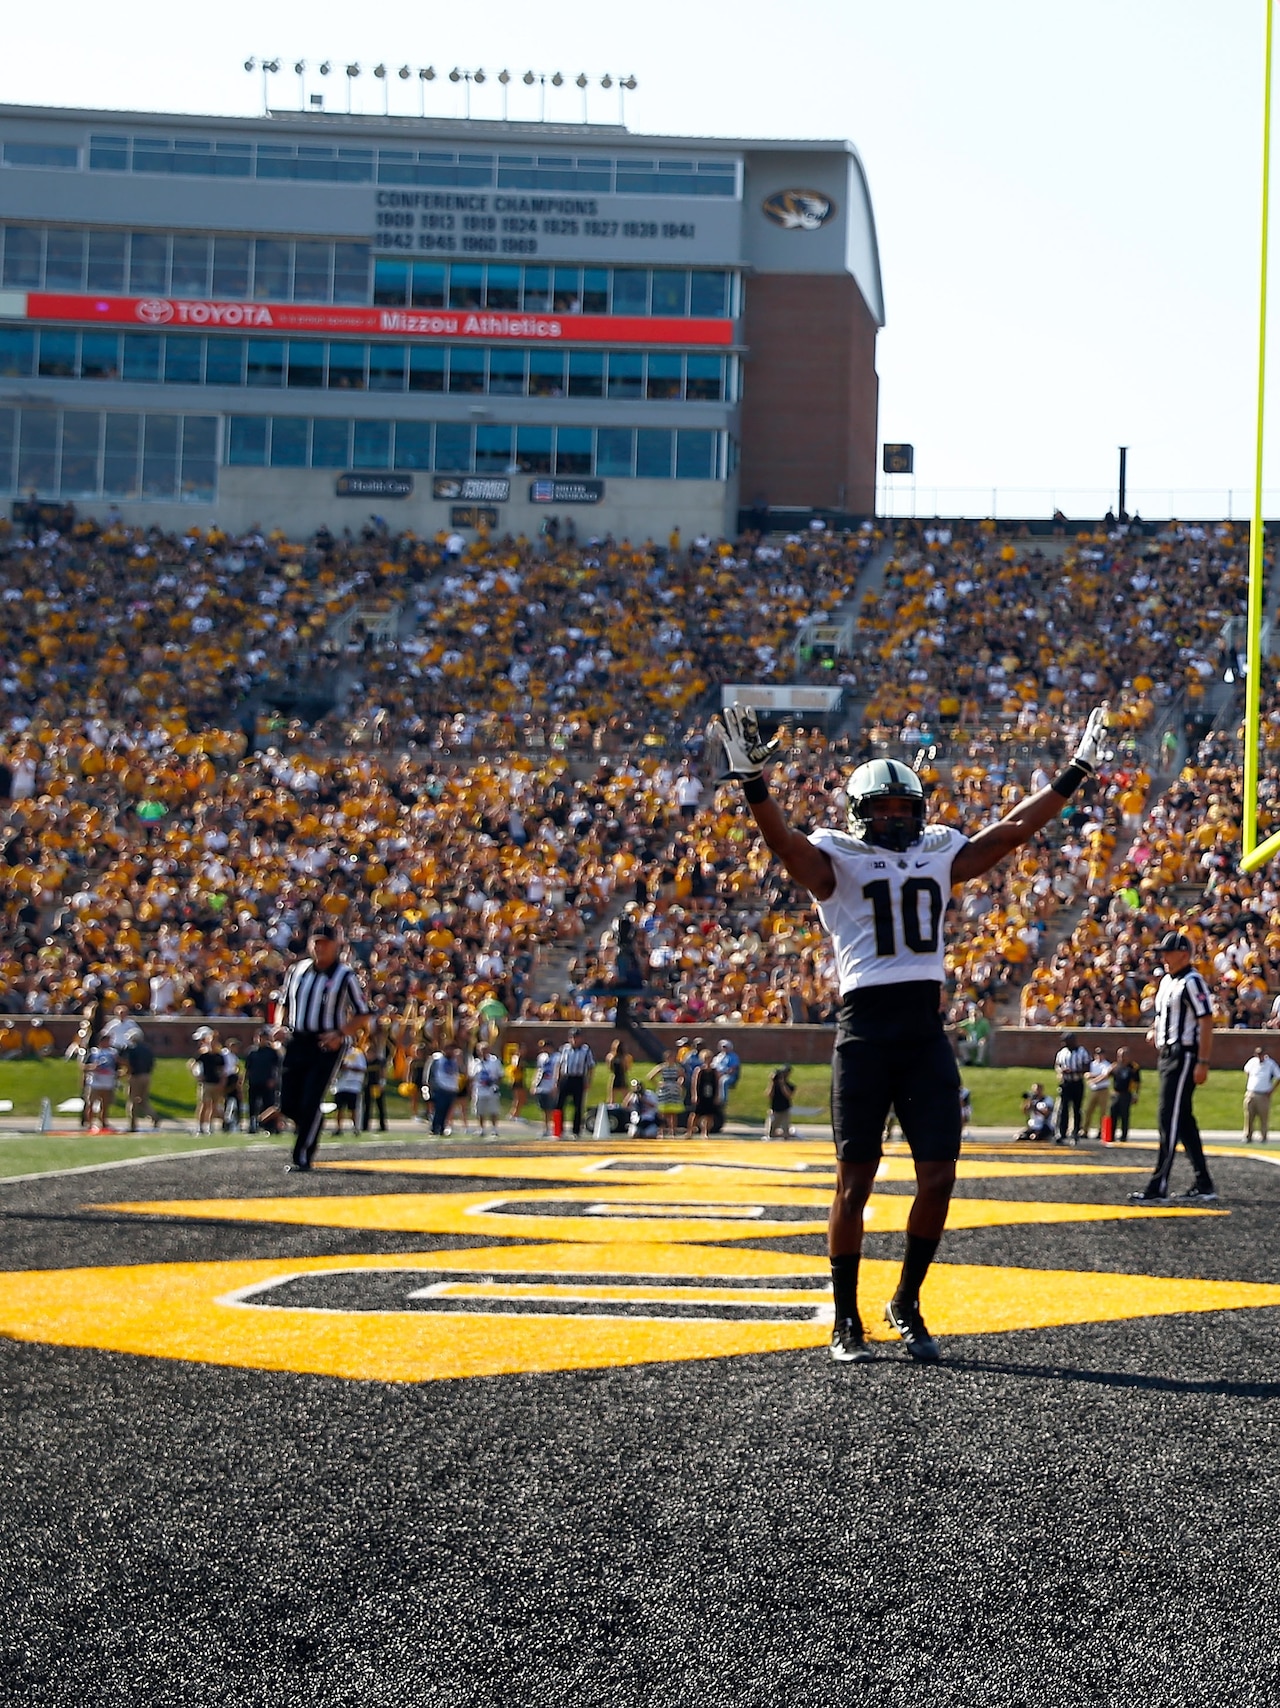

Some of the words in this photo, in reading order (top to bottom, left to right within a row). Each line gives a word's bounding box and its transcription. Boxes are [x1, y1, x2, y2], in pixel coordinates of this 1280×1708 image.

[377, 189, 488, 213] CONFERENCE
[494, 195, 598, 216] CHAMPIONS
[178, 302, 273, 326] TOYOTA
[380, 311, 458, 333] Mizzou
[464, 315, 562, 338] Athletics
[861, 876, 943, 958] 10
